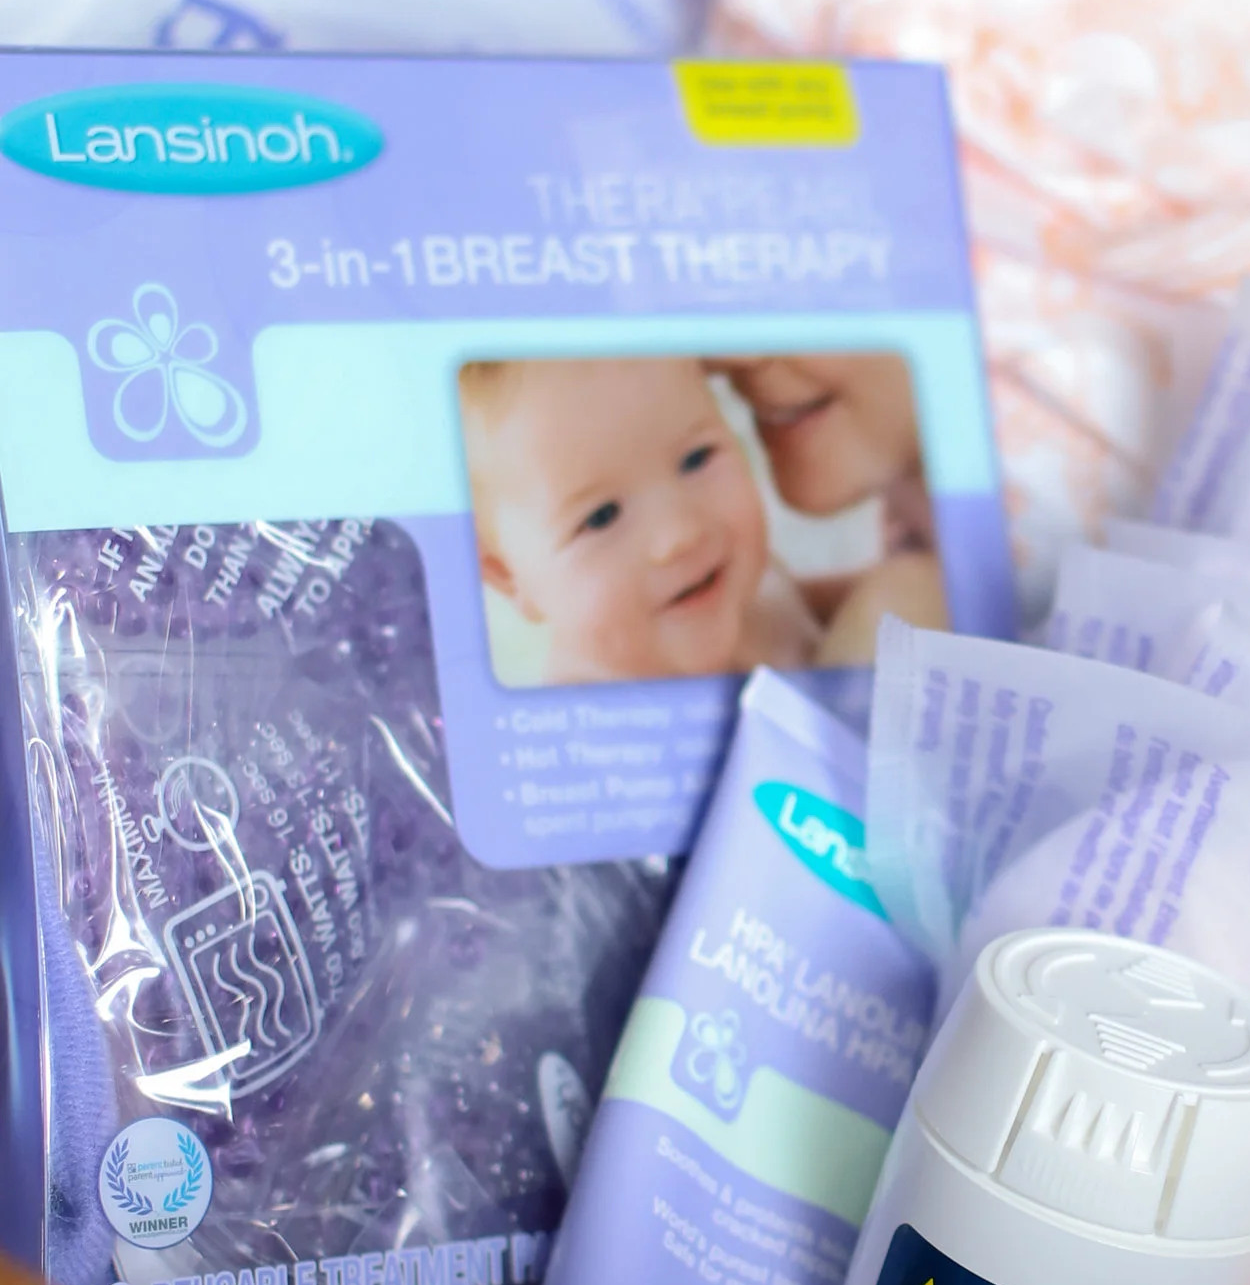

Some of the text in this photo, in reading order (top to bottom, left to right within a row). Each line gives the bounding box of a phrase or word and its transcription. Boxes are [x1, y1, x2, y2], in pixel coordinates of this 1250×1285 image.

[47, 113, 341, 165] Lansinoh
[266, 235, 893, 289] 3-in-1 BREAST THERAPY
[98, 538, 124, 572] IF
[183, 526, 217, 571] DO
[204, 536, 249, 607] THAN
[293, 577, 332, 616] TO
[91, 770, 169, 909] MAXIMUM
[129, 1216, 188, 1233] WINNER
